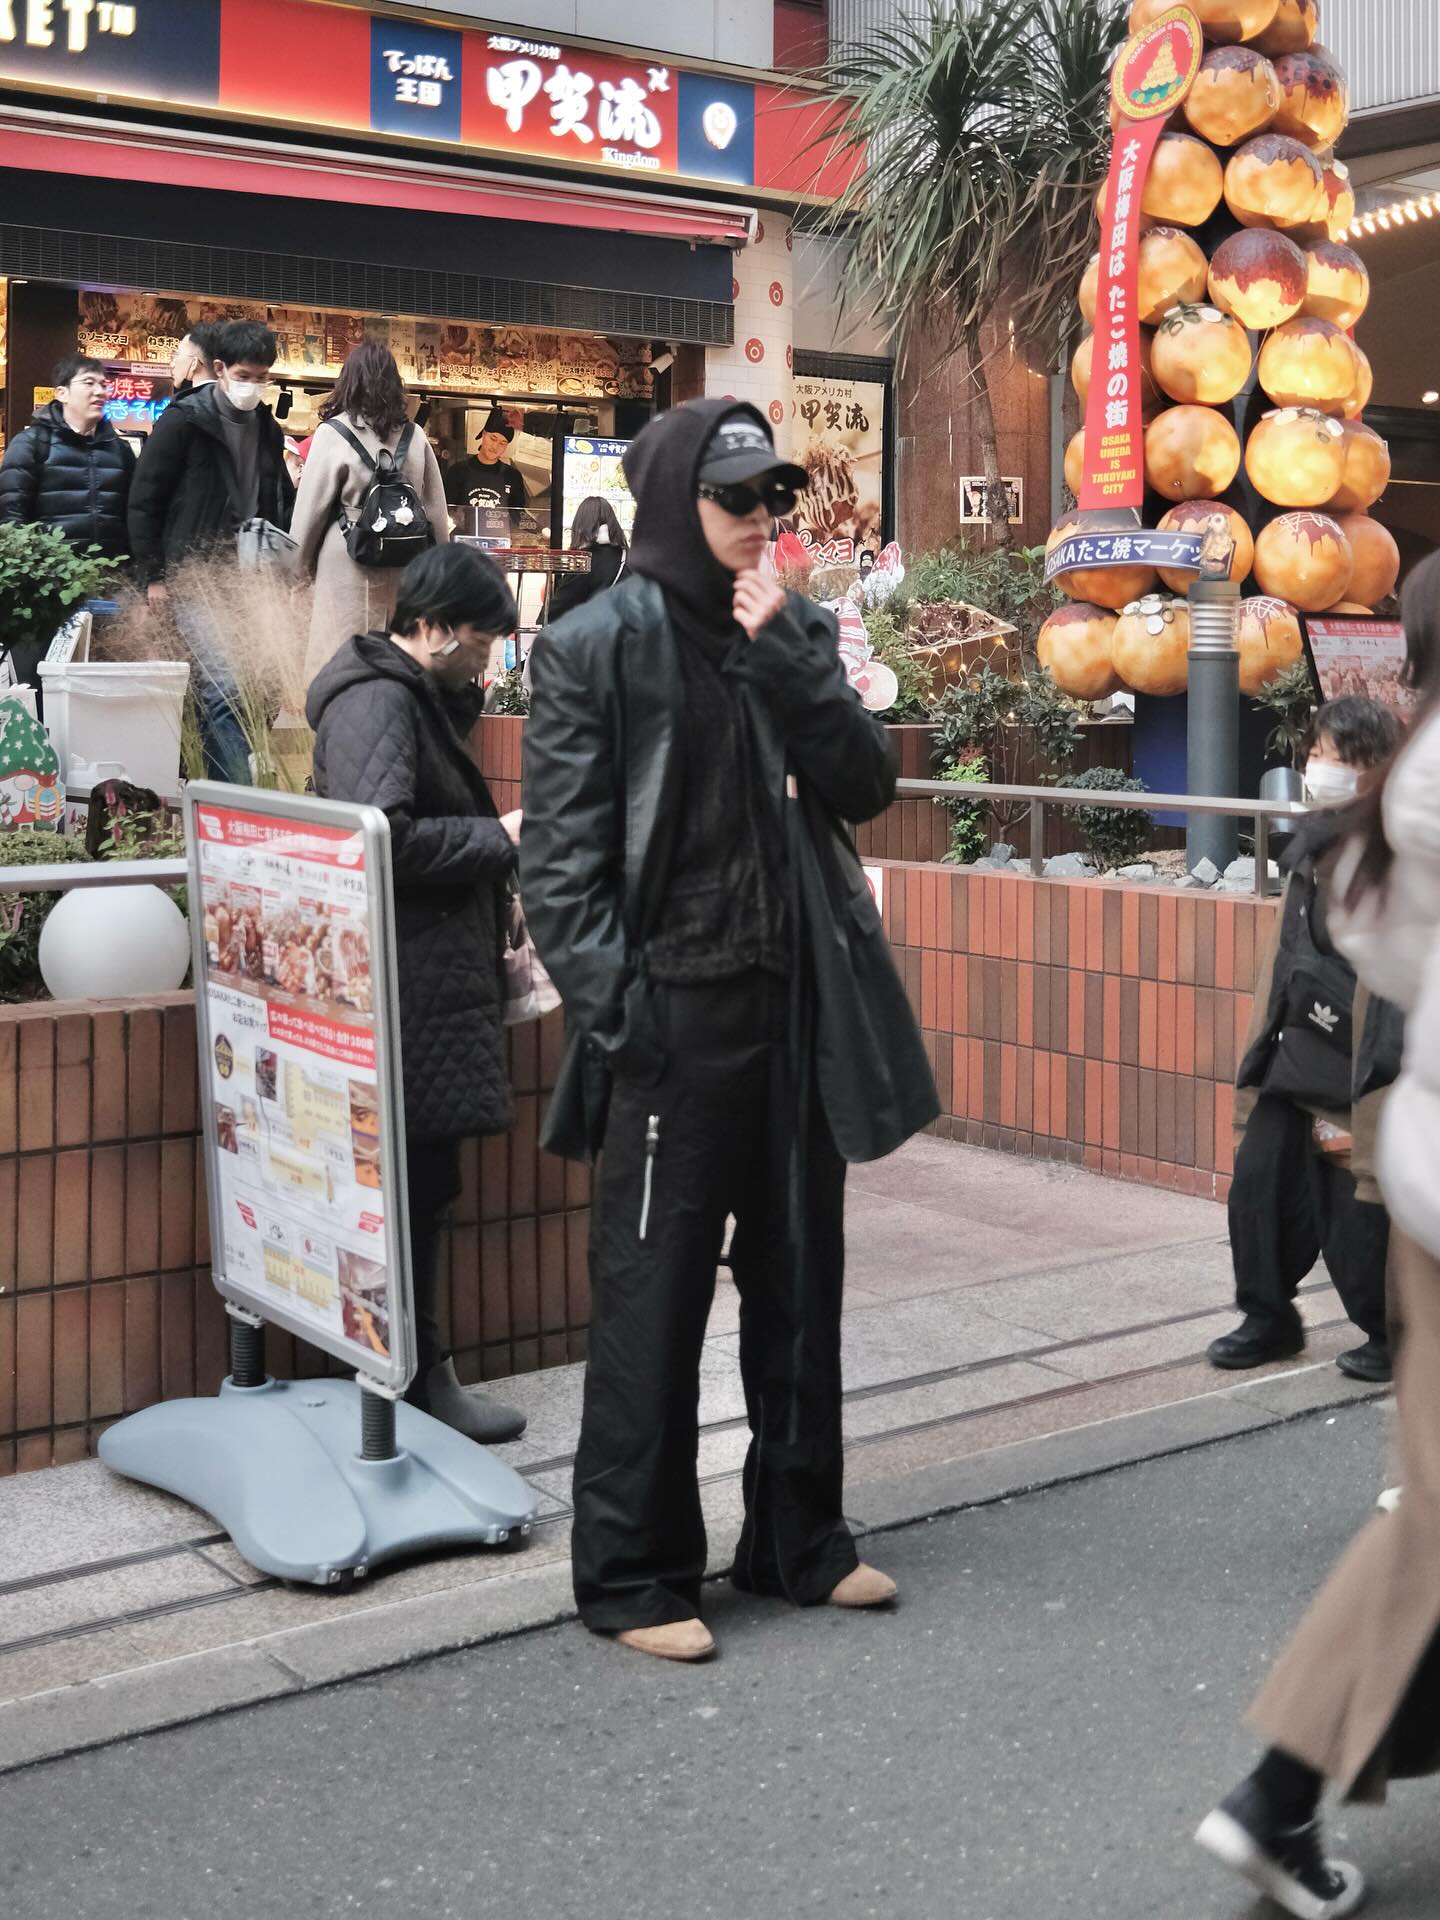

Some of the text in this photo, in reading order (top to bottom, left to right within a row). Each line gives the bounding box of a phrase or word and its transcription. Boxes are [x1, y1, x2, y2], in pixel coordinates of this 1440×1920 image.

[487, 35, 562, 60] 大阪アメリカ村
[394, 77, 443, 107] 王国
[486, 59, 663, 149] 甲賀流
[601, 146, 661, 170] Kingdom
[796, 384, 853, 399] 大阪アメリカ村
[800, 399, 870, 433] 甲賀流
[1101, 433, 1131, 446] OSAKA
[1100, 446, 1131, 459] UMEDA
[1110, 459, 1121, 470] IS
[1092, 469, 1137, 484] TAKOYAKI
[1102, 483, 1125, 495] CITY
